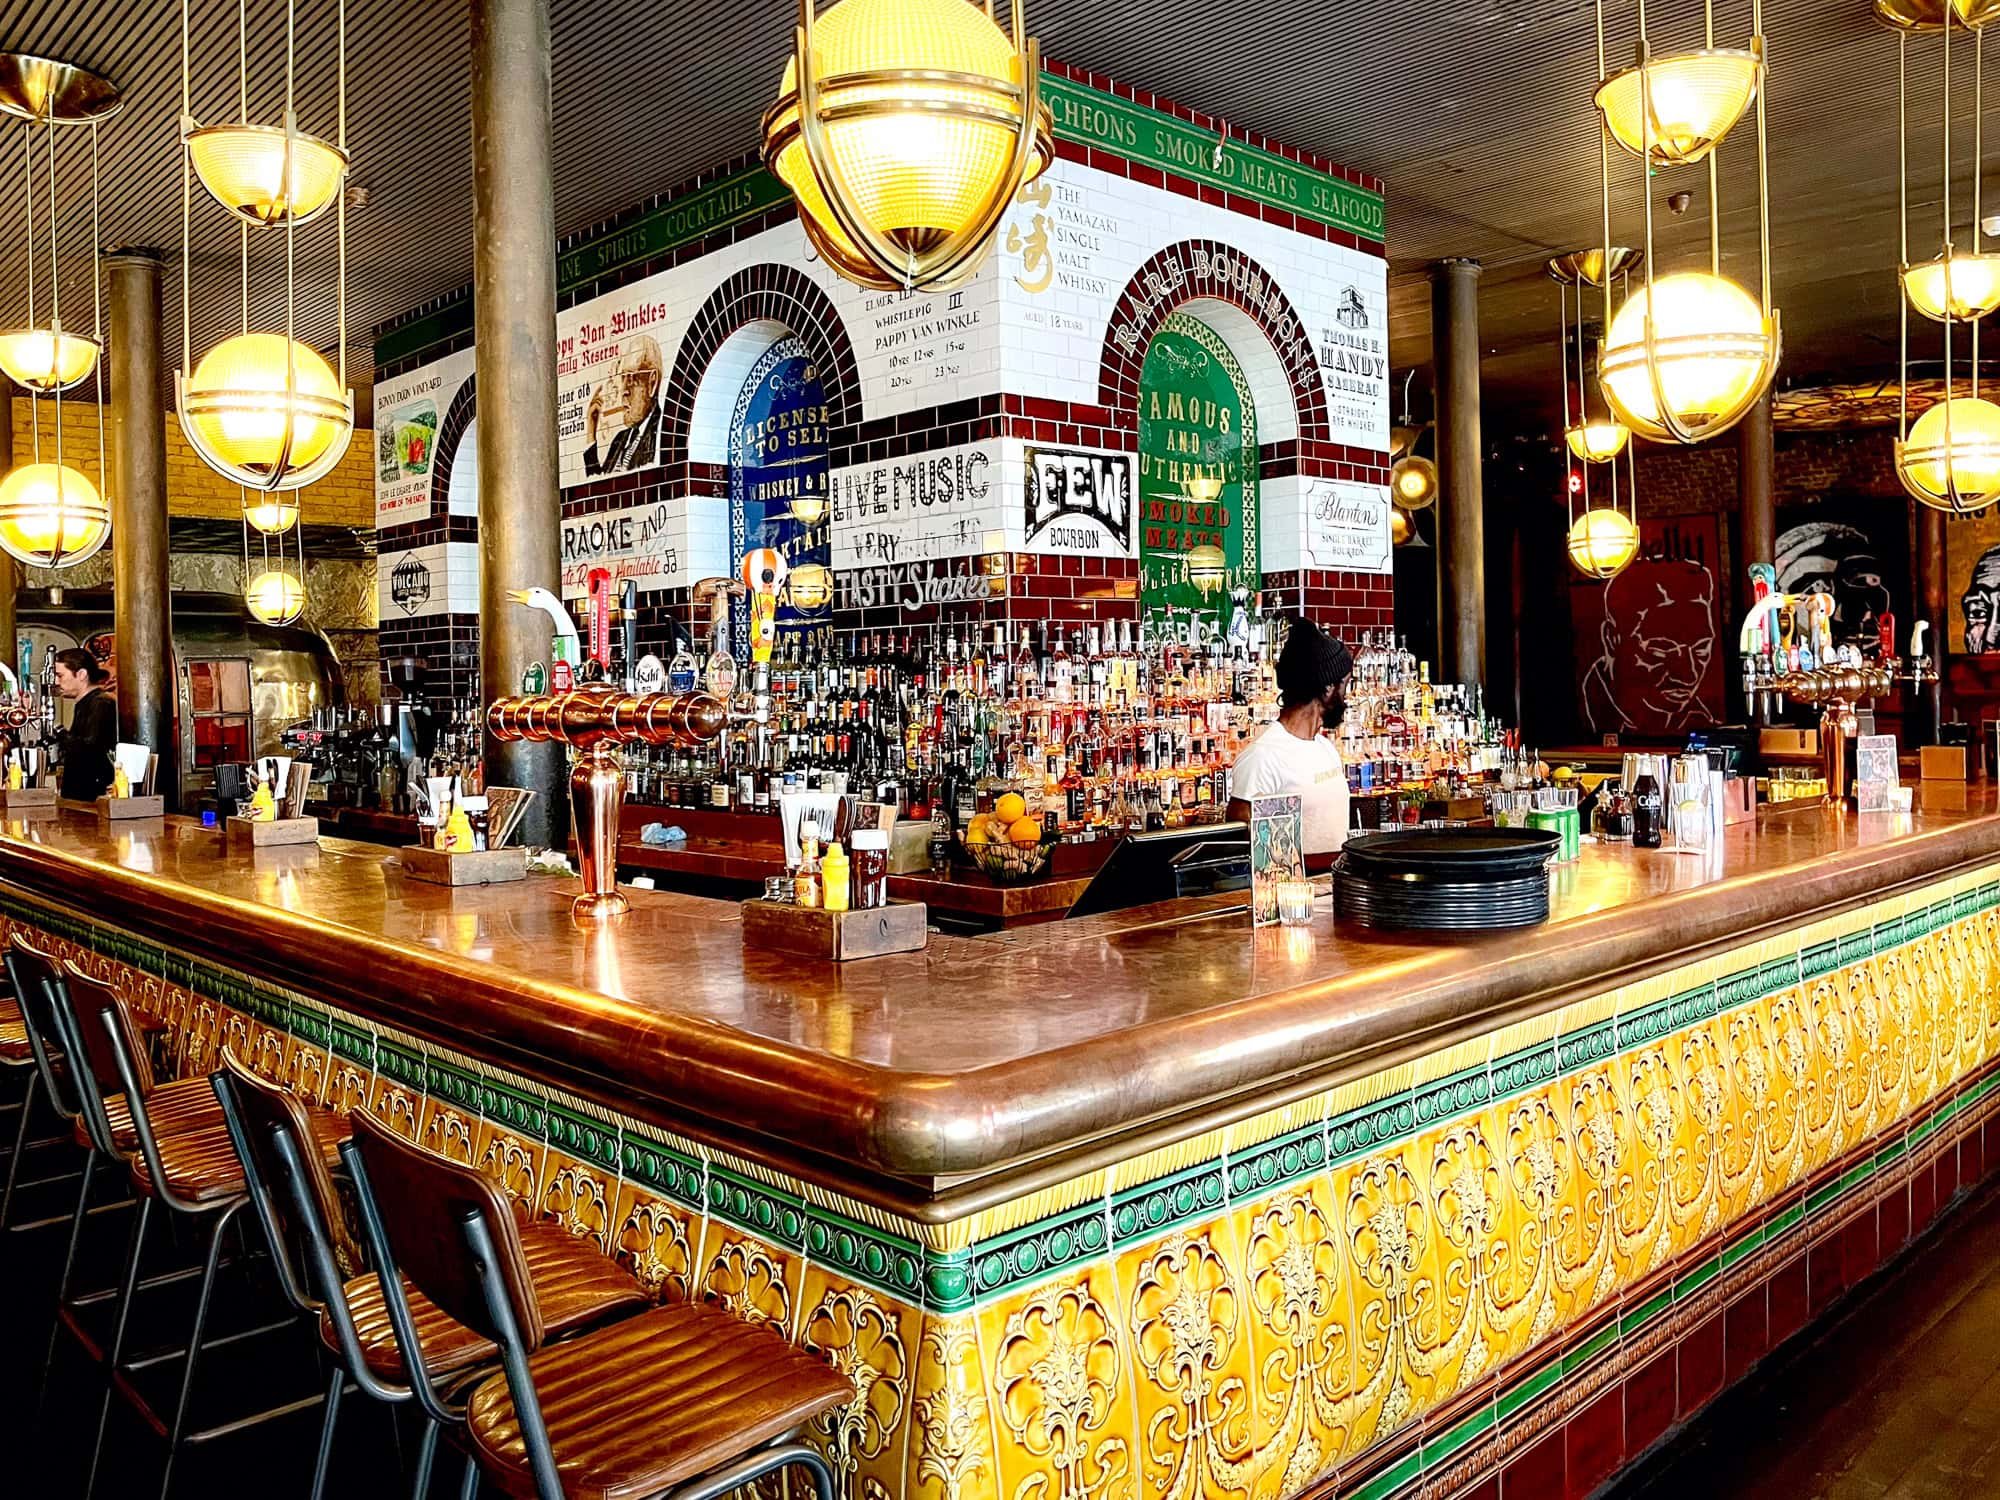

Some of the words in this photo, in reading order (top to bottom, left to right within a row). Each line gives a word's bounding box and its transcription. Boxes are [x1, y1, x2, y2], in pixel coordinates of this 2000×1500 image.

[1041, 91, 1137, 146] CHEONS
[1155, 130, 1235, 178] SMOKD
[1241, 159, 1297, 200] MEATS
[1056, 185, 1081, 204] THE
[1312, 185, 1382, 228] SEAFOOD
[598, 228, 647, 266] SPIRITS
[666, 182, 752, 238] COCKTAILS
[1058, 207, 1118, 234] YAMAZAKI
[1057, 228, 1101, 251] SINGLE
[1057, 251, 1091, 271] MALT
[1058, 272, 1107, 295] WHISKY
[580, 323, 605, 345] Van
[611, 303, 666, 335] Winkles
[875, 302, 932, 329] WHISTLEPIG
[875, 330, 907, 351] PAPPY
[911, 324, 933, 340] VAN
[936, 310, 980, 334] WINKLE
[1114, 258, 1184, 358] RARE
[1193, 248, 1315, 389] BOURBONS
[582, 344, 619, 366] Reserve
[1322, 328, 1368, 351] THOMAS
[1319, 345, 1384, 380] HANDY
[577, 381, 591, 398] old
[755, 435, 779, 458] TO
[788, 426, 829, 447] SEL
[1167, 429, 1200, 454] AND
[749, 477, 800, 501] WHISKEY
[805, 474, 813, 490] &
[833, 468, 888, 522] LIVE
[893, 451, 990, 511] MUSIC
[1034, 453, 1125, 526] FEW
[1314, 490, 1378, 526] Blanton's
[561, 517, 633, 560] RAOKE
[640, 504, 667, 547] AND
[852, 532, 900, 563] VERY
[1050, 527, 1099, 549] BOURBON
[393, 571, 429, 591] VOLCANO
[614, 555, 661, 582] Available
[835, 567, 905, 609] TASTY
[904, 562, 991, 611] Shakes
